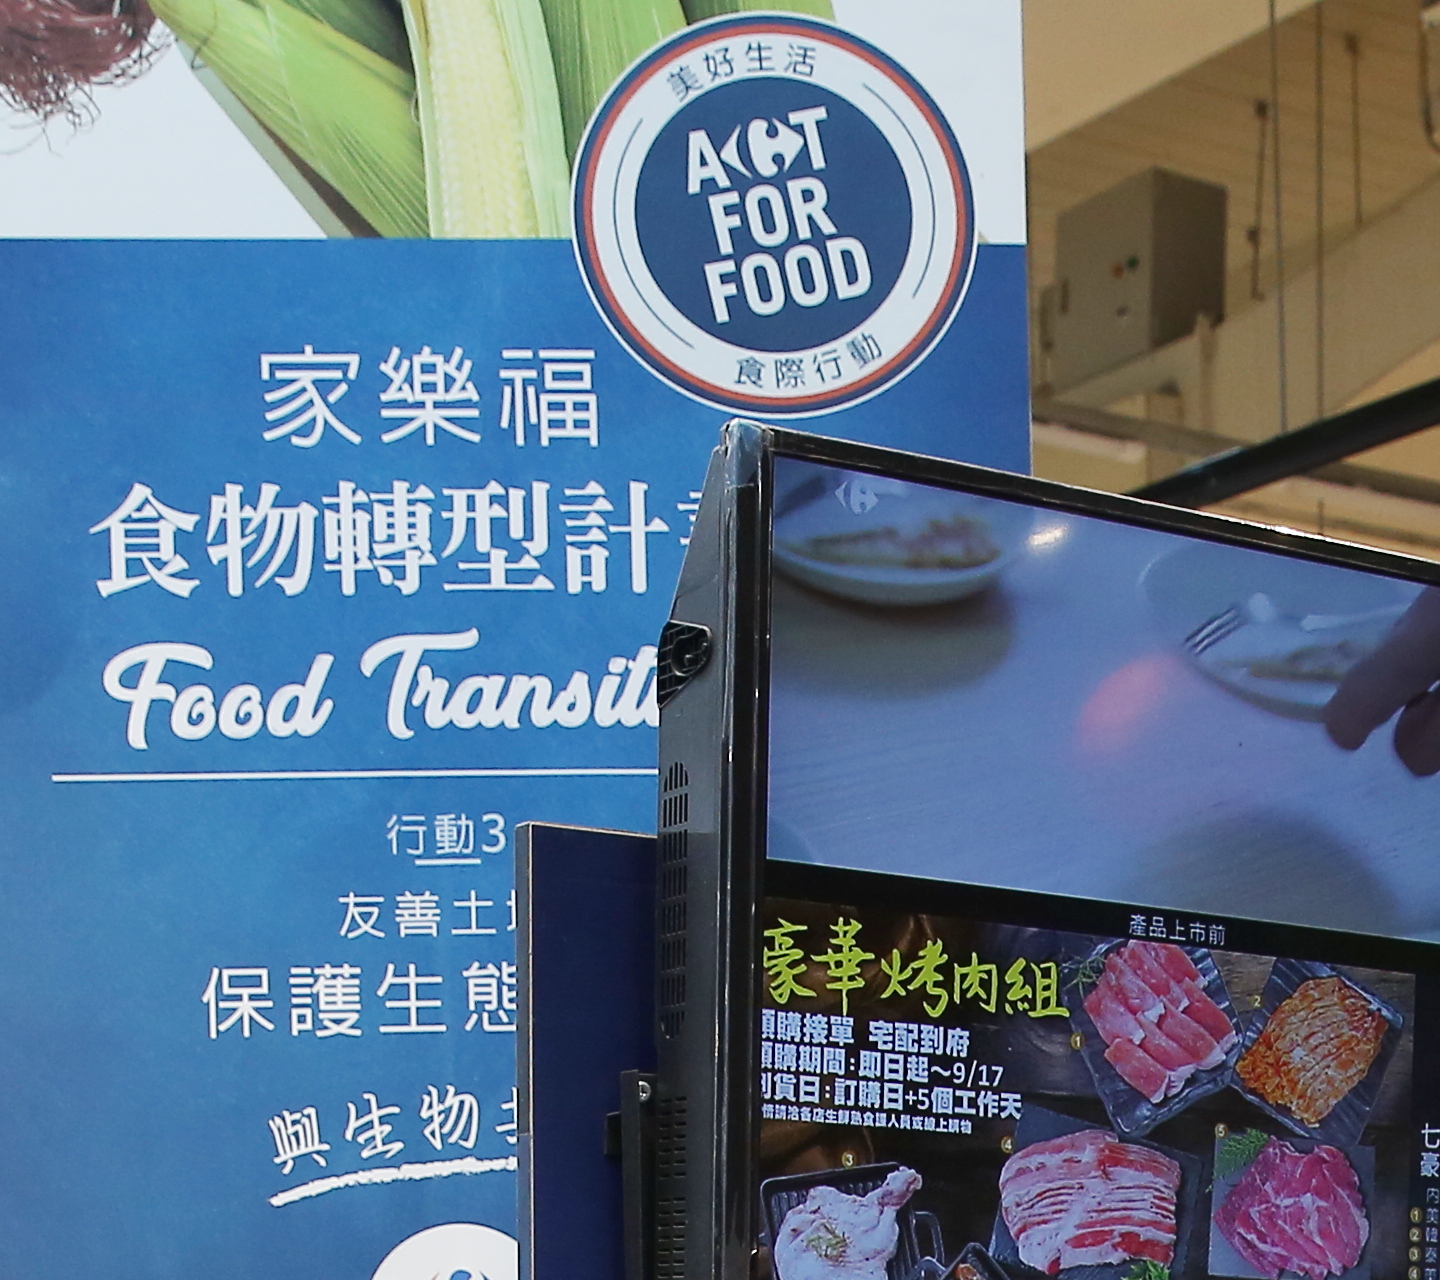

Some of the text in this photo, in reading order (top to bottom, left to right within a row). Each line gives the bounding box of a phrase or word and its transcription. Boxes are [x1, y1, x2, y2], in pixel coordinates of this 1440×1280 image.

[666, 42, 817, 102] 美好生活
[708, 176, 838, 256] FOR
[704, 236, 872, 324] FOOD
[260, 343, 600, 449] 家樂福
[734, 331, 884, 389] 食際行動
[87, 478, 702, 600] 食物轉型計
[102, 641, 336, 752] Food
[338, 890, 517, 940] 友善土
[201, 962, 517, 1040] 保護生態
[762, 916, 1070, 1019] 豪華烤肉組
[868, 1019, 970, 1058] 宅配到府
